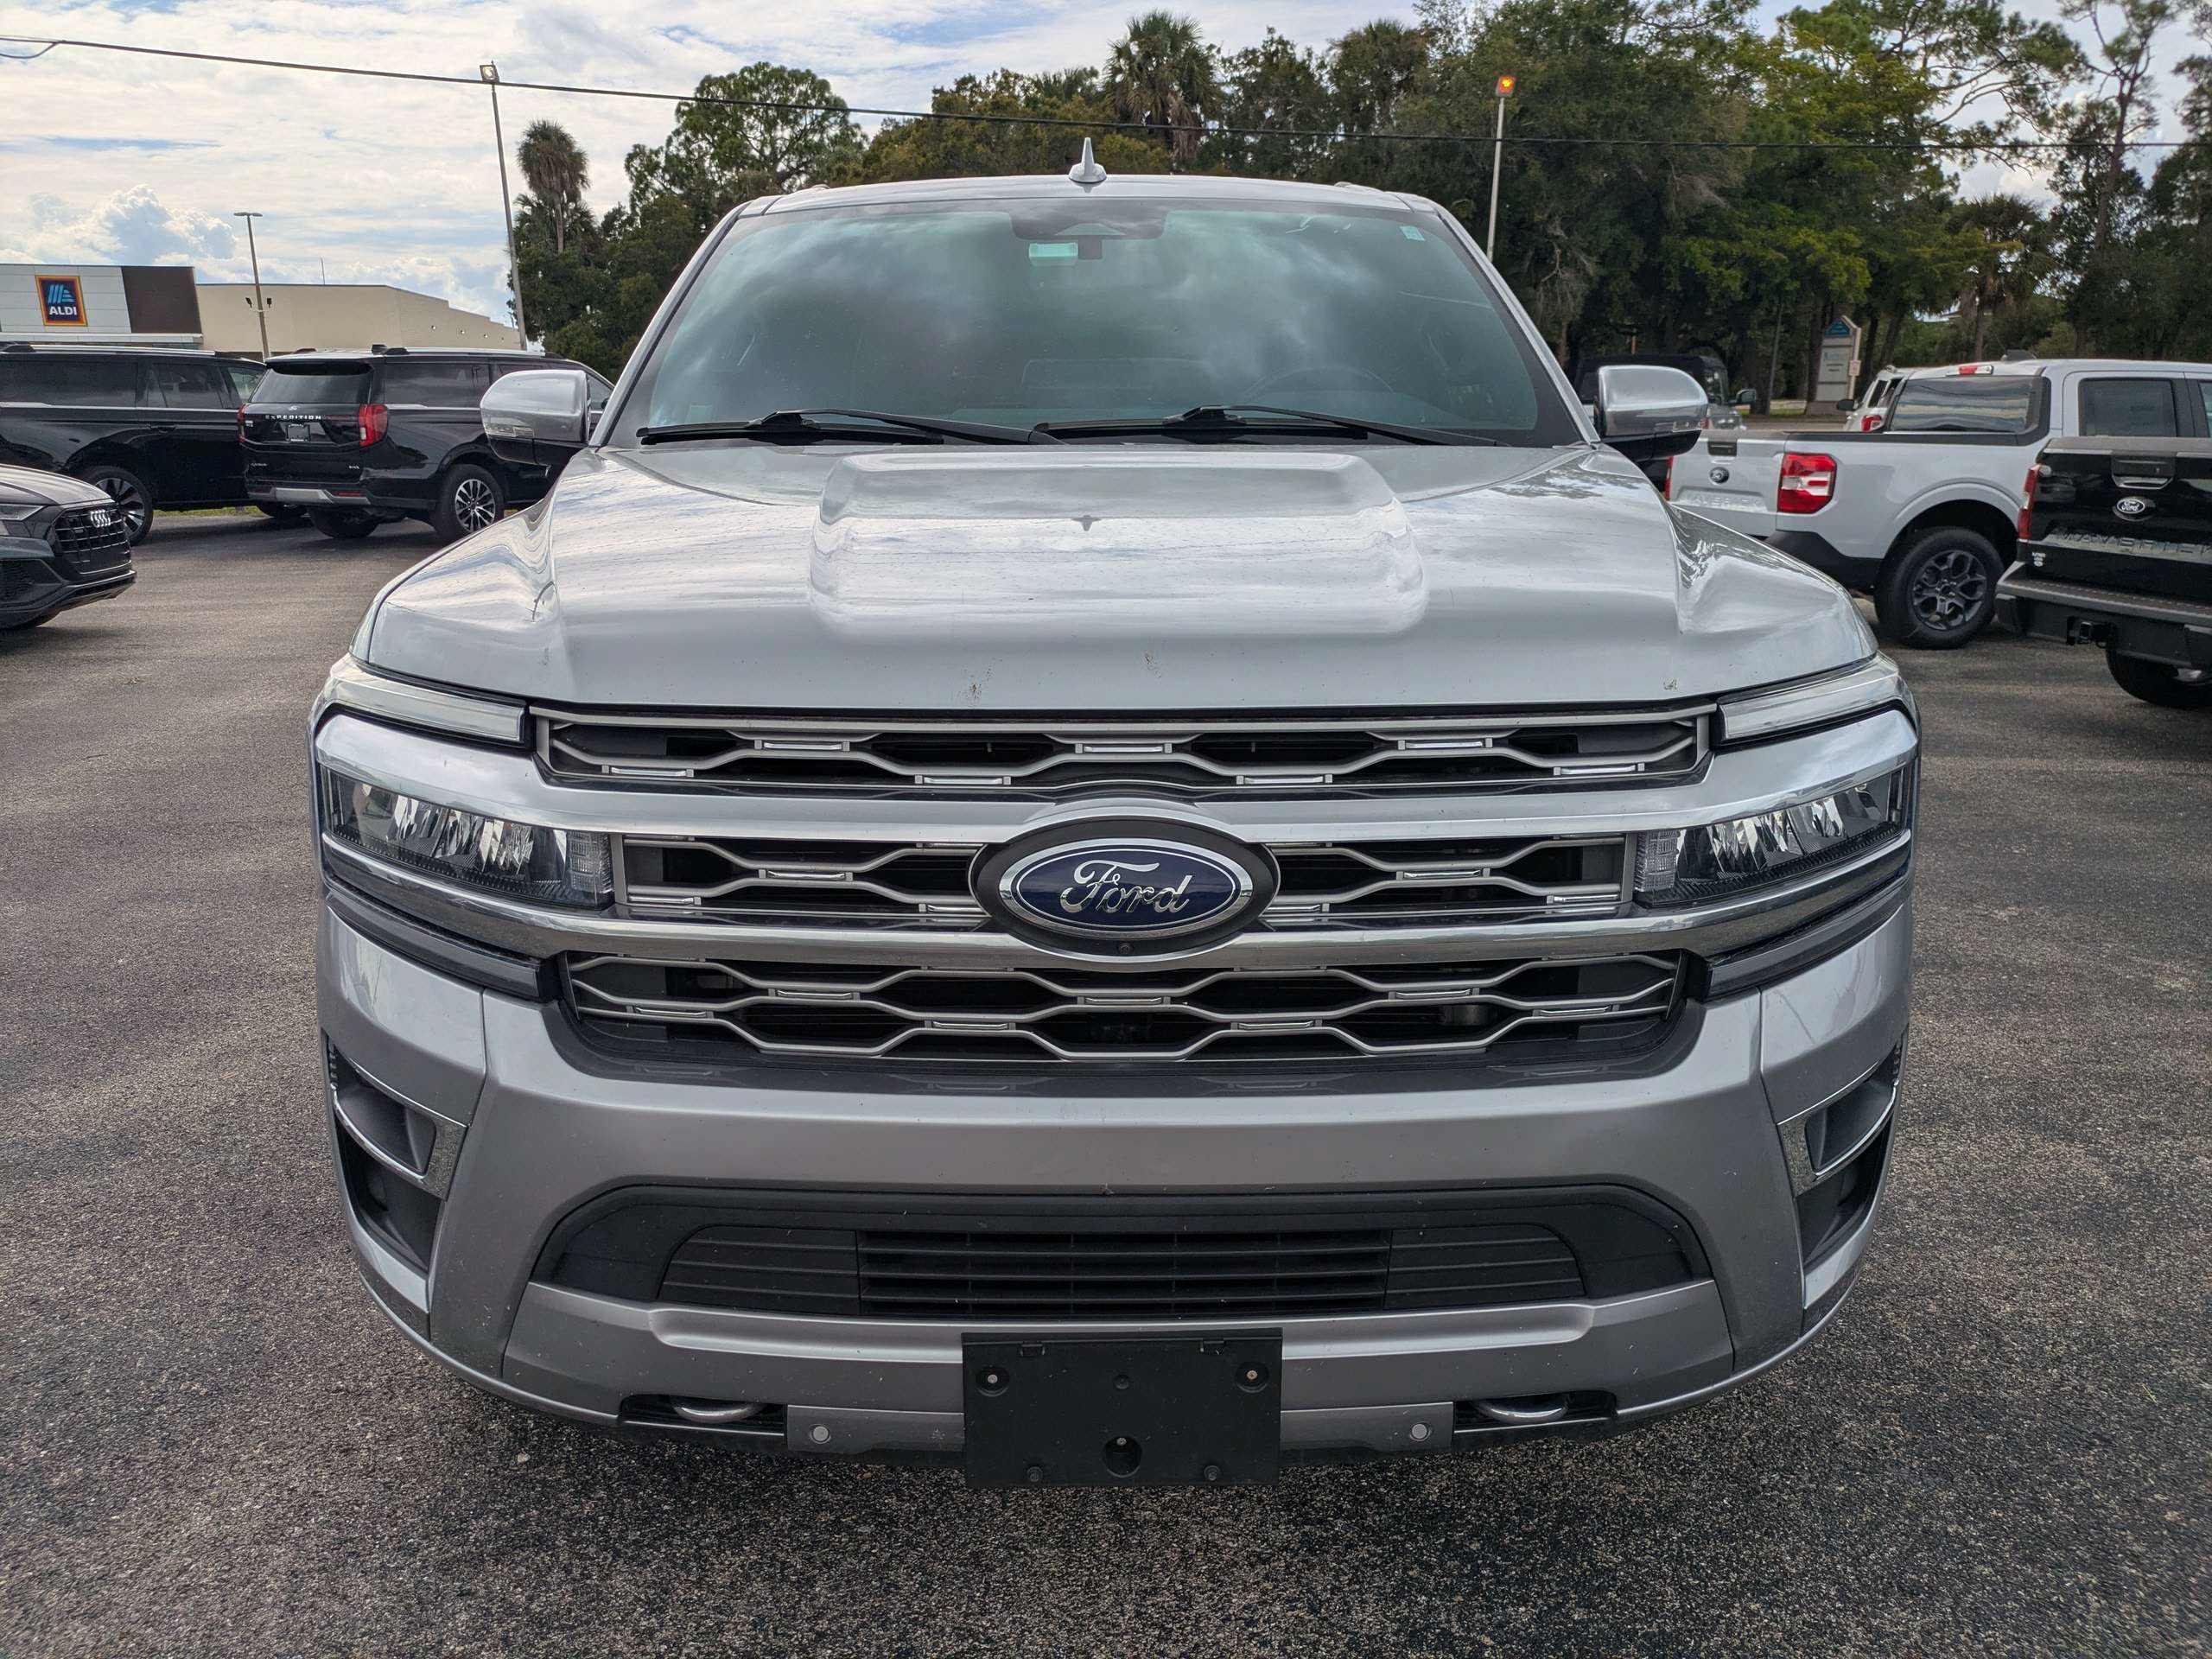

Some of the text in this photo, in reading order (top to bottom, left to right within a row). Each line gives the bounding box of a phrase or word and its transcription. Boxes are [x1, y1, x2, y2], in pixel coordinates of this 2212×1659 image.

[49, 306, 78, 316] ALDI
[2121, 500, 2140, 512] Ford
[1059, 860, 1192, 913] Ford
